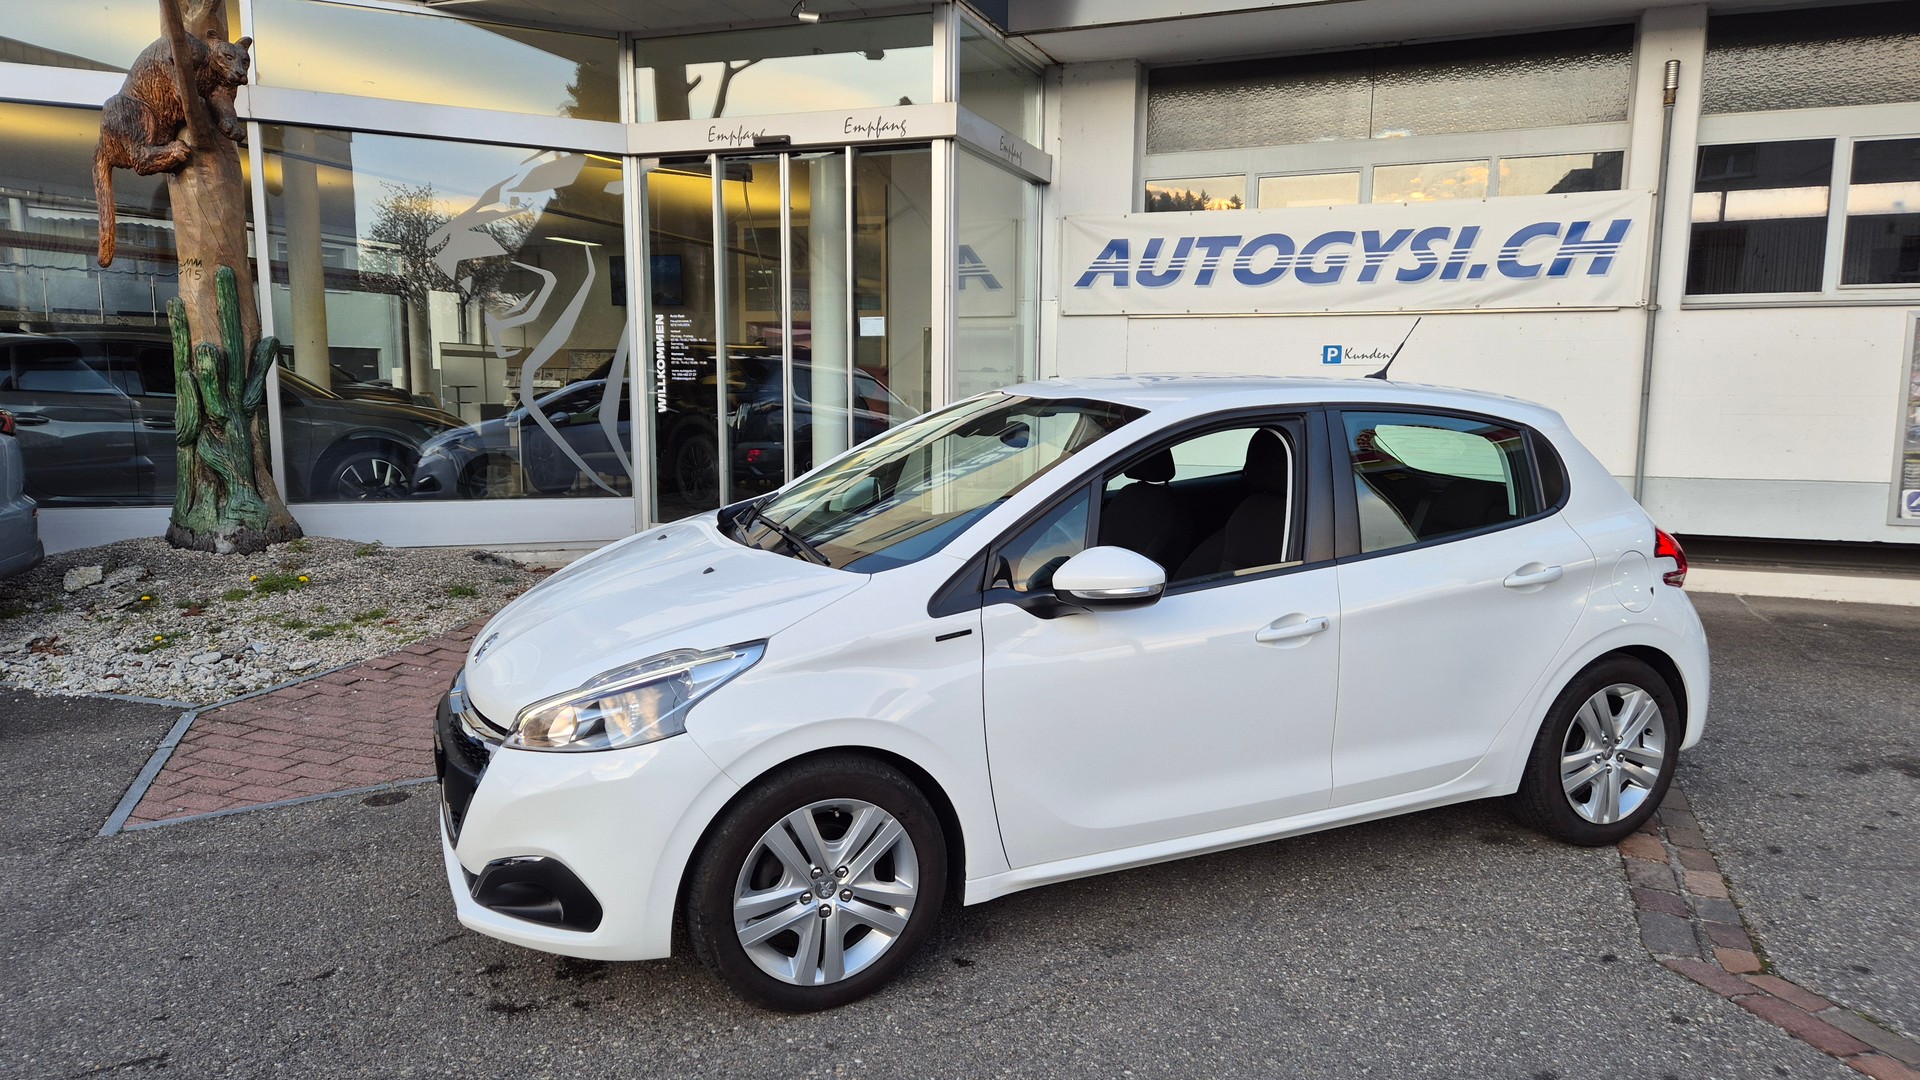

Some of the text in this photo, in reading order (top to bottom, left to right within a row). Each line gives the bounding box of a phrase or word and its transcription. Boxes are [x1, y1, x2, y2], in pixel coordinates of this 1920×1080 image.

[844, 115, 907, 138] Empfang
[1073, 218, 1634, 289] AUTOGYSI.CH
[655, 314, 667, 413] WILLKOMMEN
[1326, 346, 1391, 362] P Kunden
